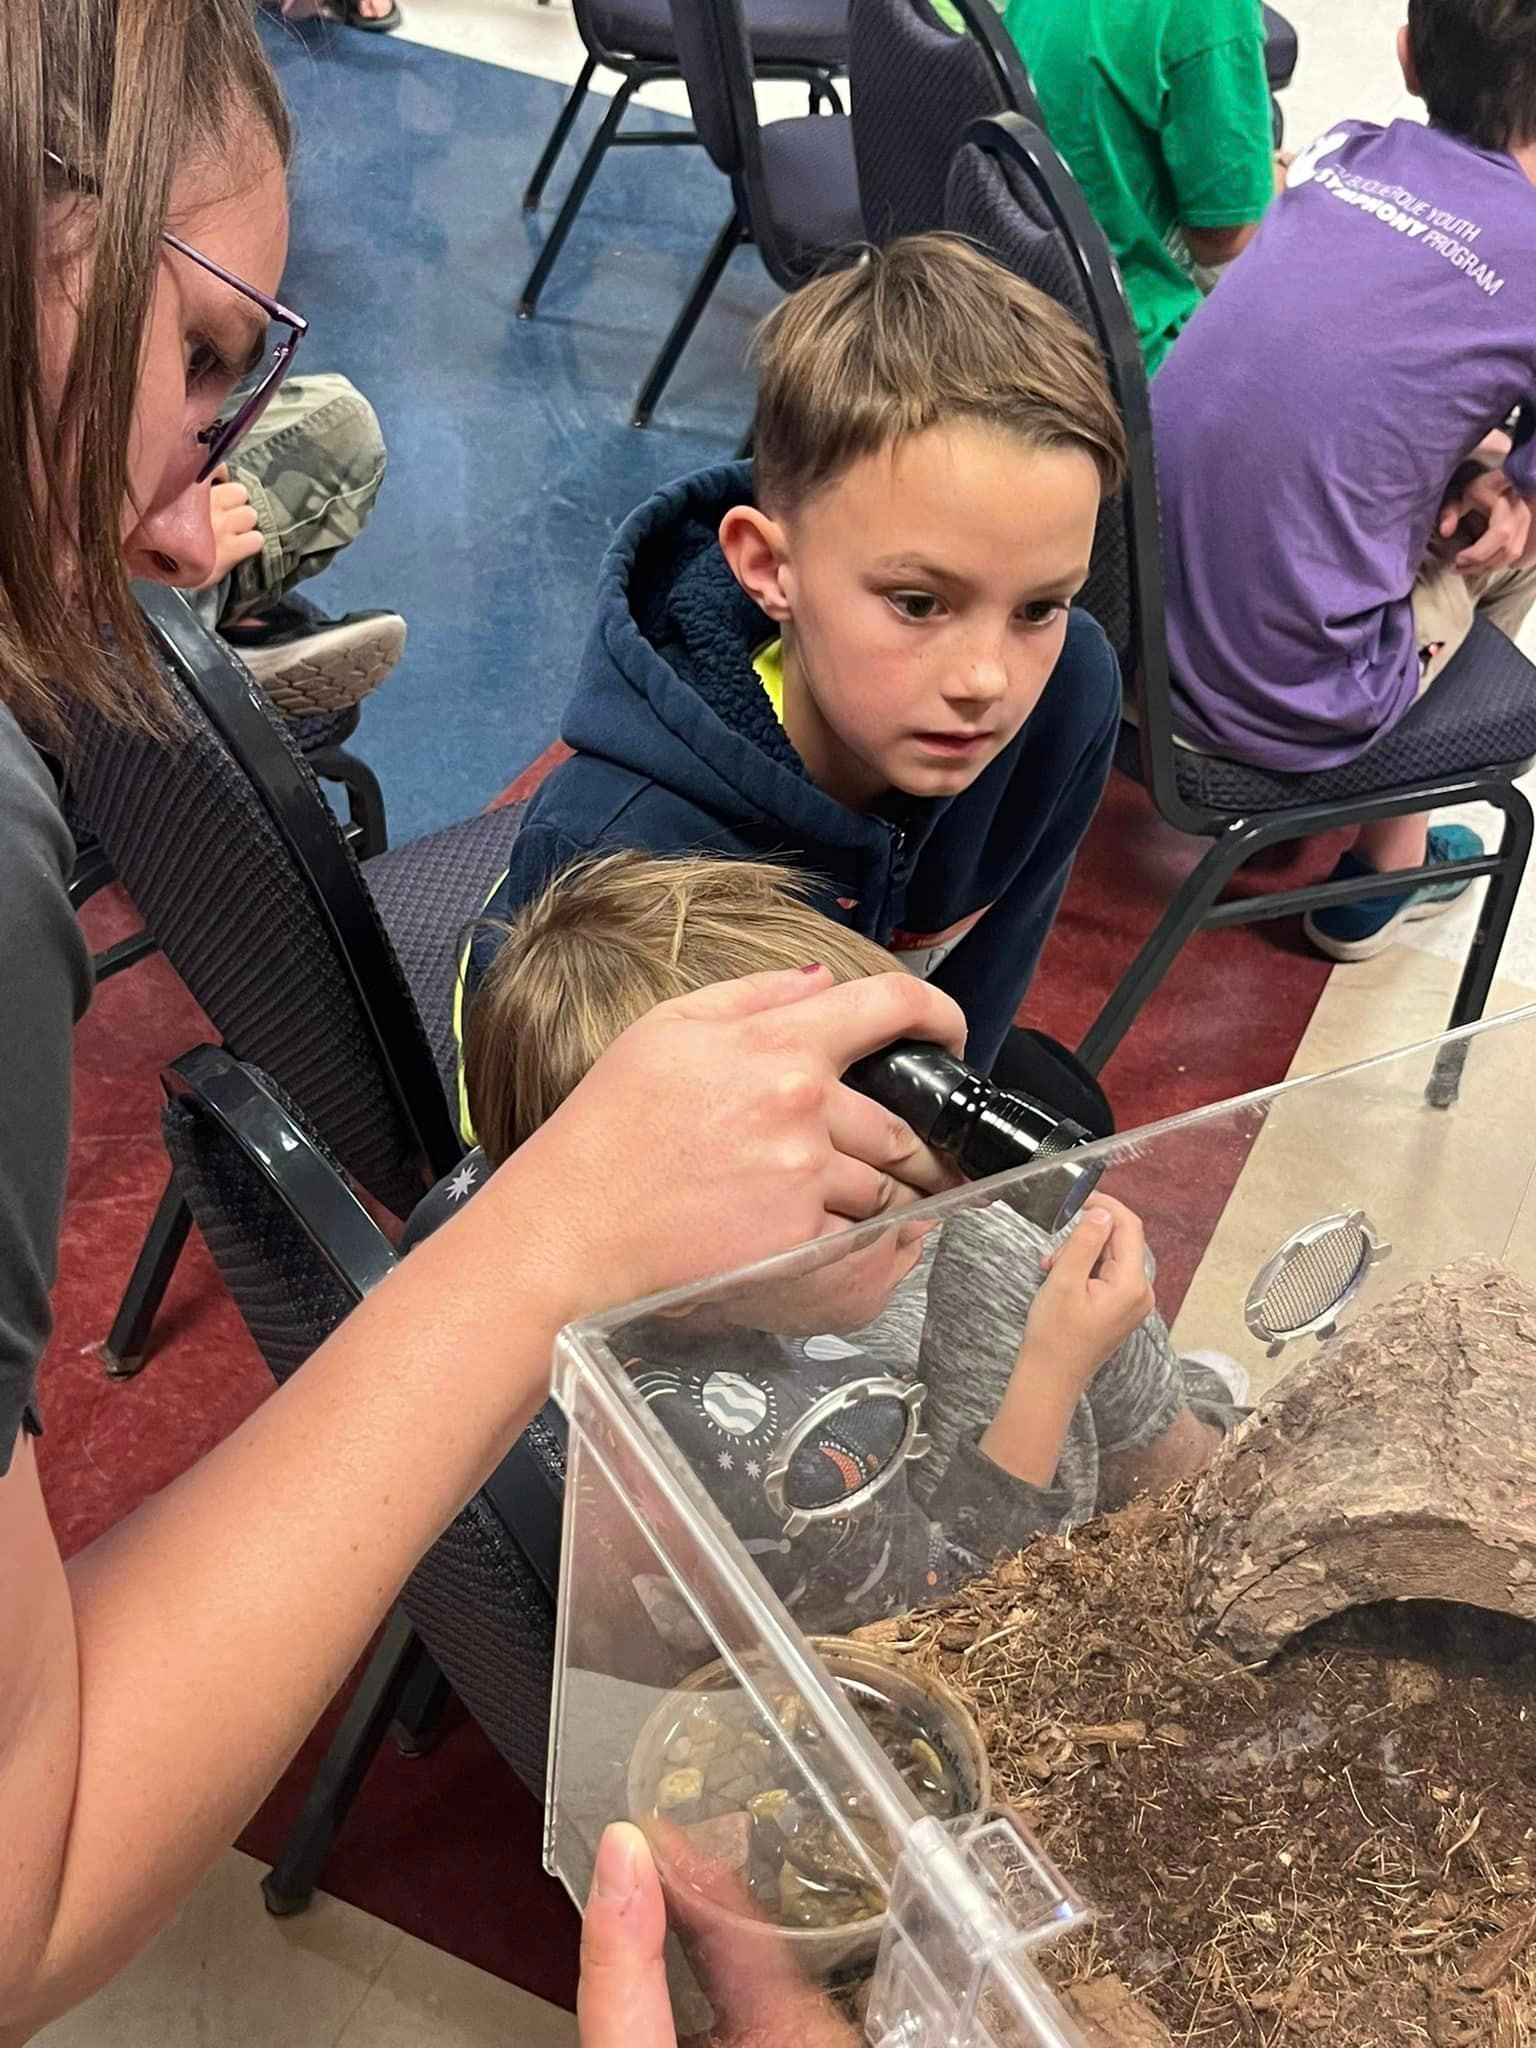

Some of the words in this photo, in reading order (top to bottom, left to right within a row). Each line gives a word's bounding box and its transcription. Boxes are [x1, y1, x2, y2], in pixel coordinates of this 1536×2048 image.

[1313, 168, 1429, 237] SYMPHONY
[1421, 230, 1504, 296] PROGRAM
[1425, 207, 1482, 242] YOUTH
